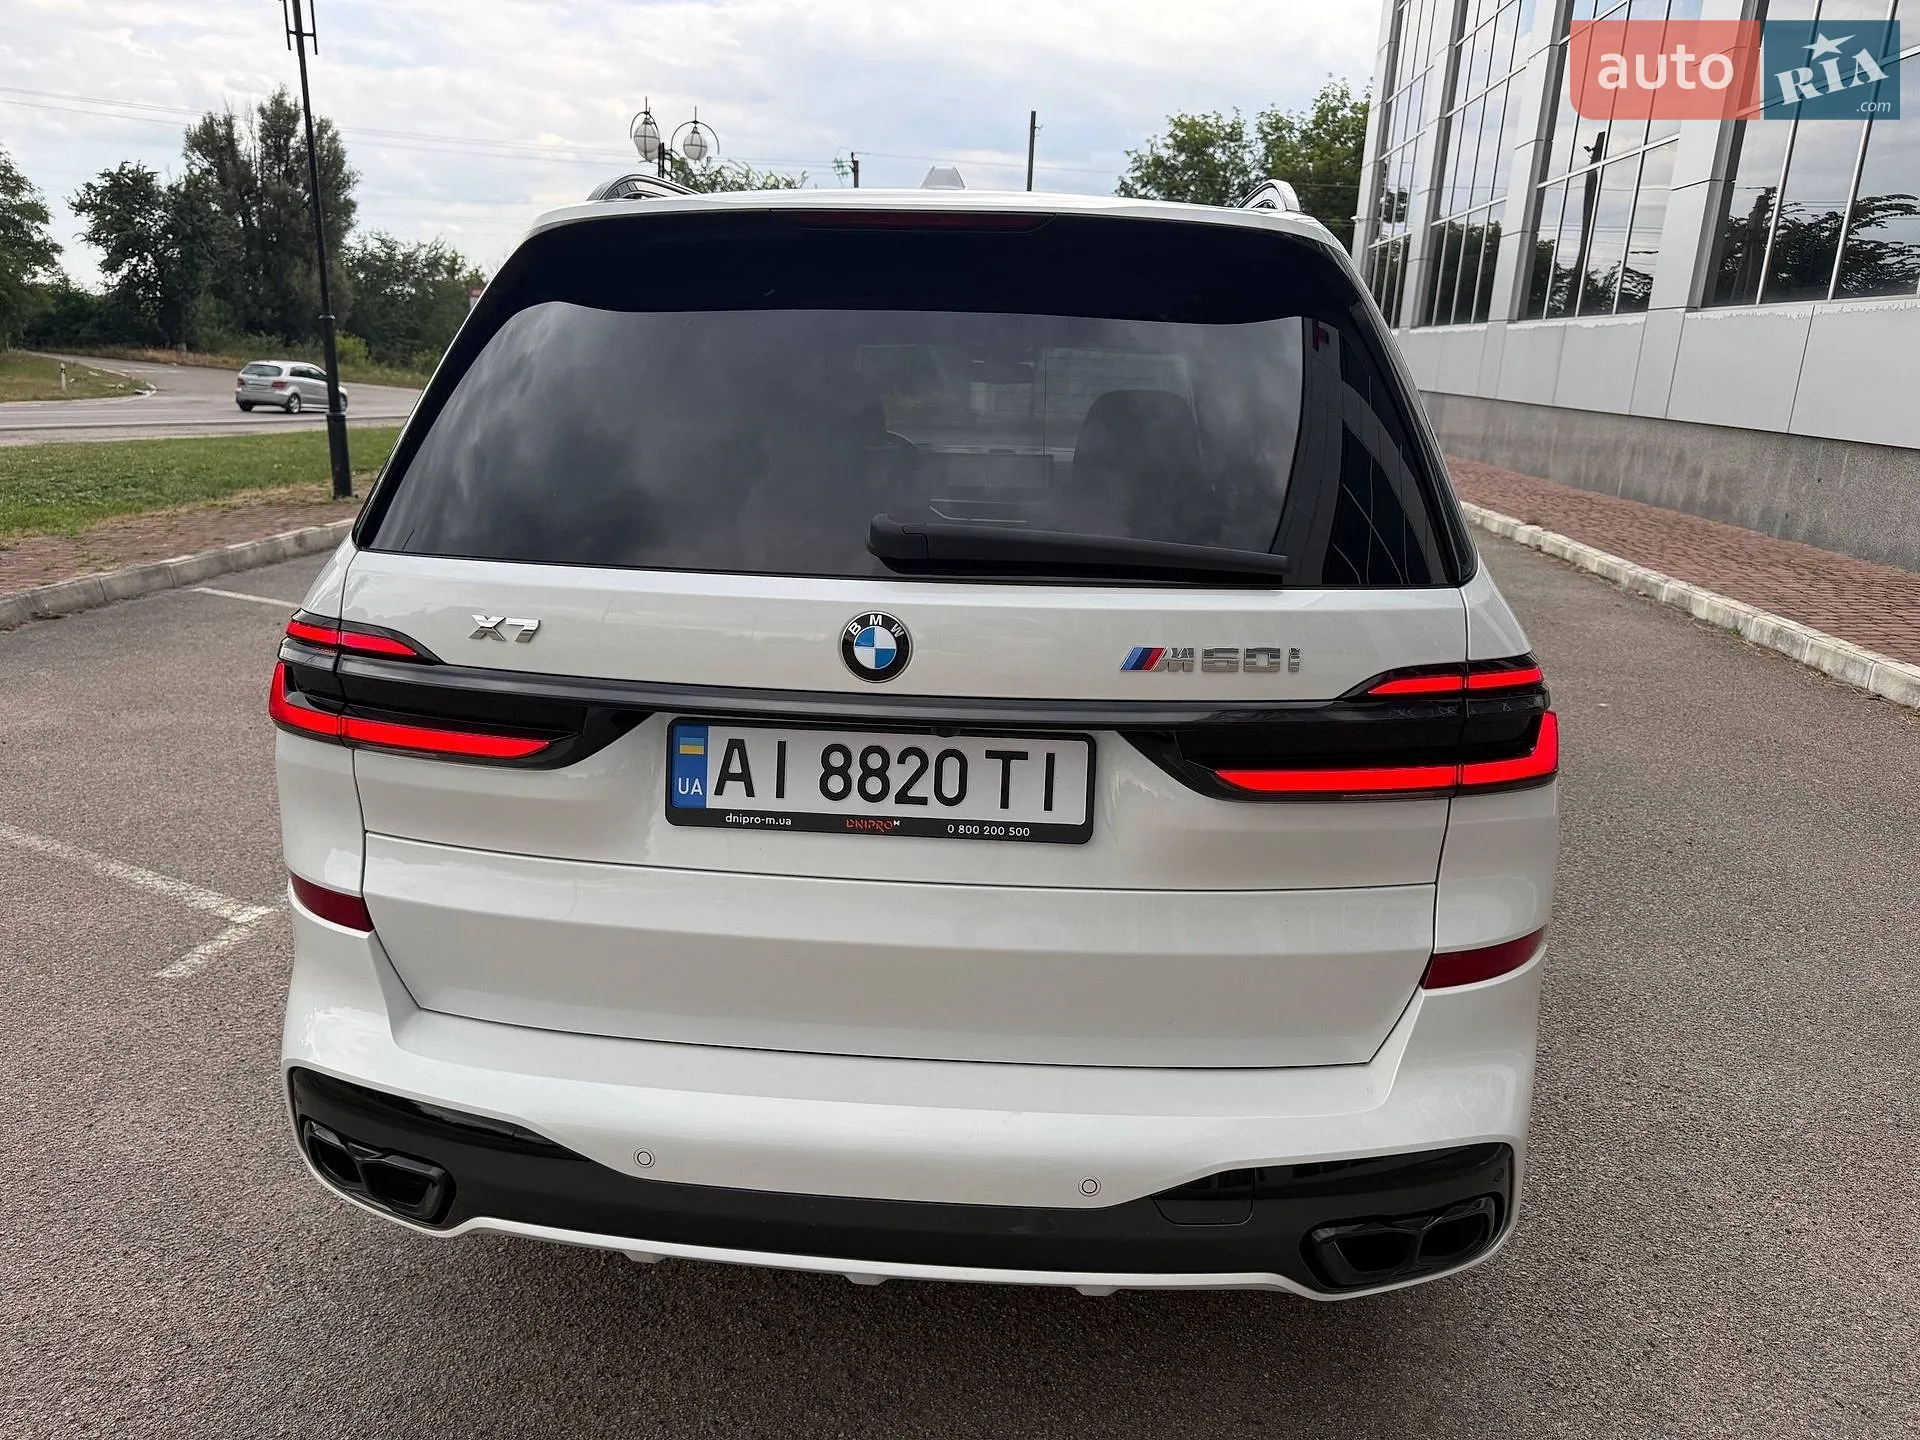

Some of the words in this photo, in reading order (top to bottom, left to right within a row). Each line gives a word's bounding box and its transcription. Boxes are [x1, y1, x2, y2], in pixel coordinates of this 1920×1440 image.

[468, 613, 541, 643] X7
[848, 614, 905, 638] BMW
[713, 738, 788, 799] AI
[818, 743, 969, 807] 8820
[984, 749, 1056, 812] TI
[677, 777, 704, 796] UA
[725, 812, 792, 826] dnipro-m.ua
[947, 824, 955, 834] 0
[958, 824, 980, 835] 800
[983, 825, 1006, 836] 200
[1008, 826, 1031, 838] 500
